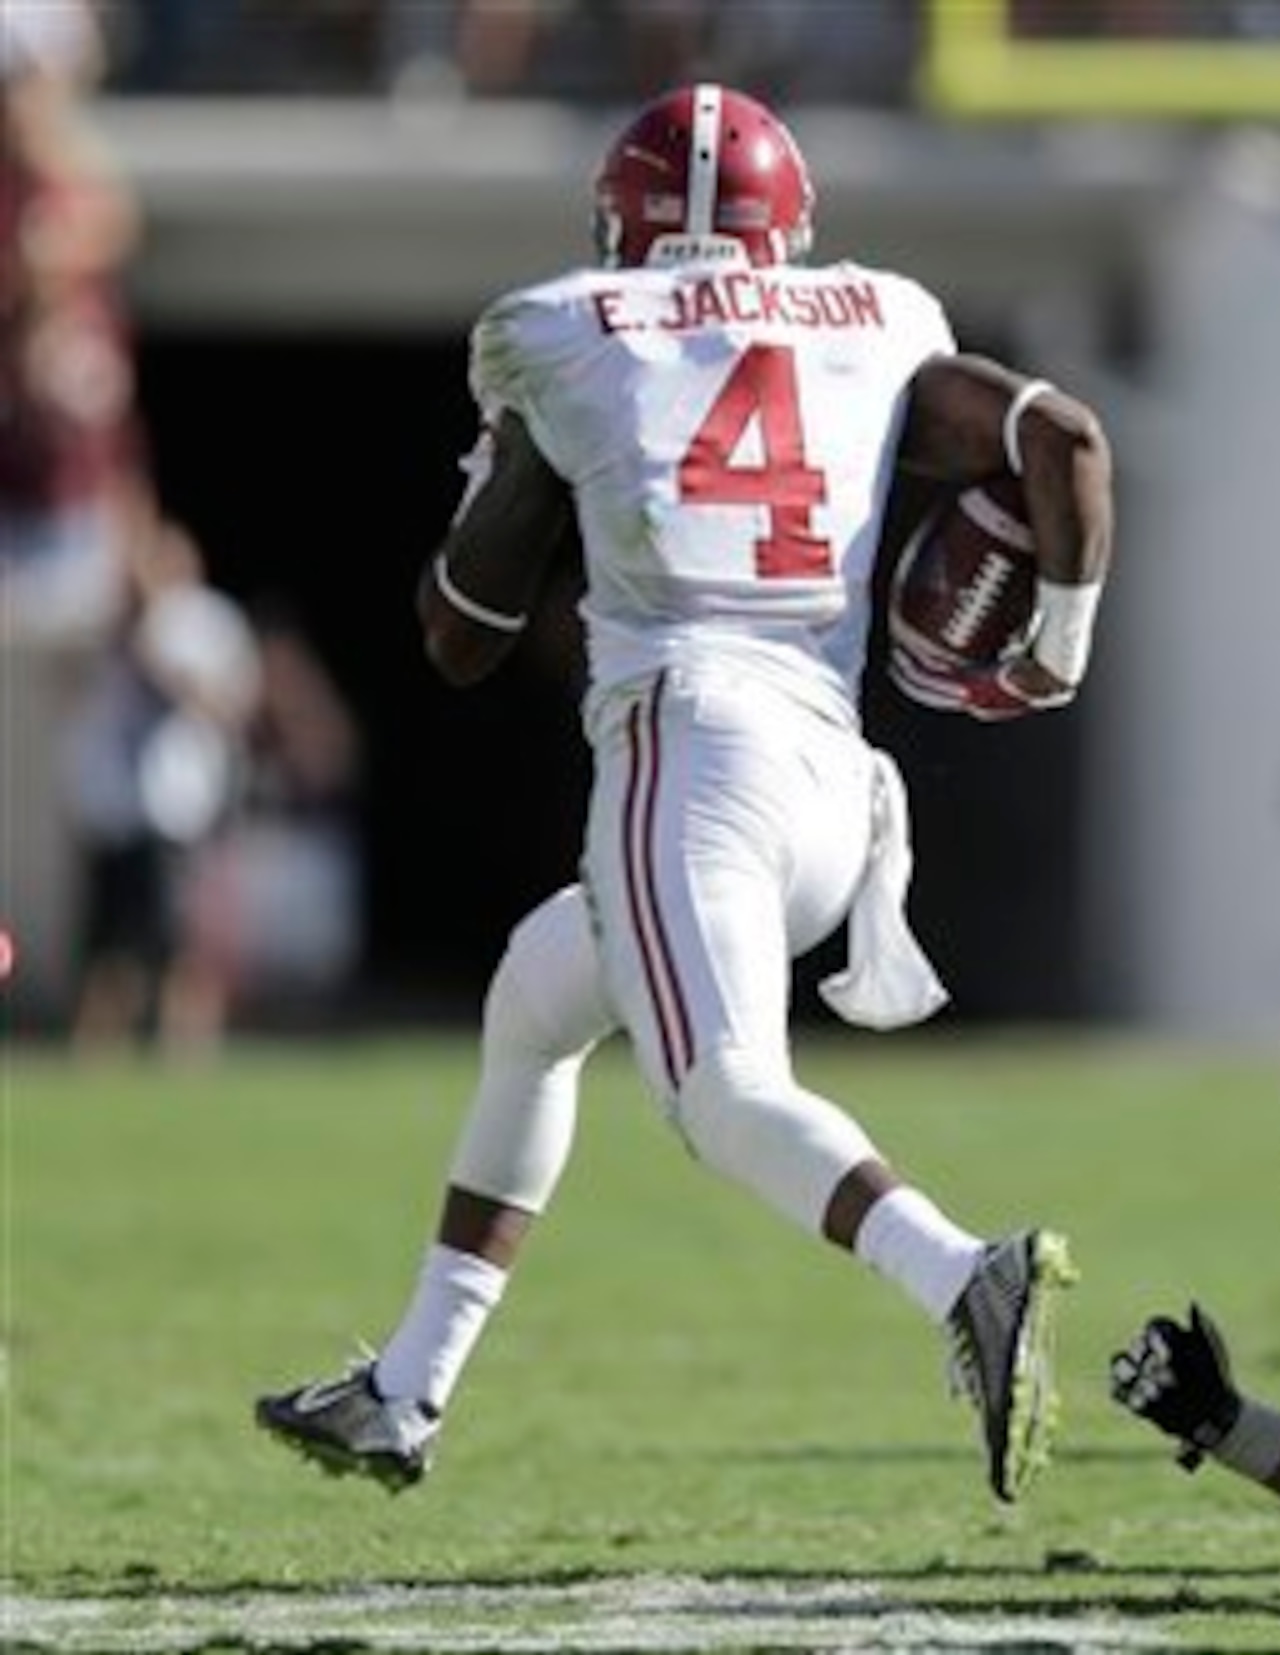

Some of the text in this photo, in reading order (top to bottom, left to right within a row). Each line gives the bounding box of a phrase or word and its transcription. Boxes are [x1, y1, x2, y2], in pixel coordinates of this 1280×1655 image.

[591, 272, 887, 335] E. JACKSON
[676, 341, 836, 581] 4
